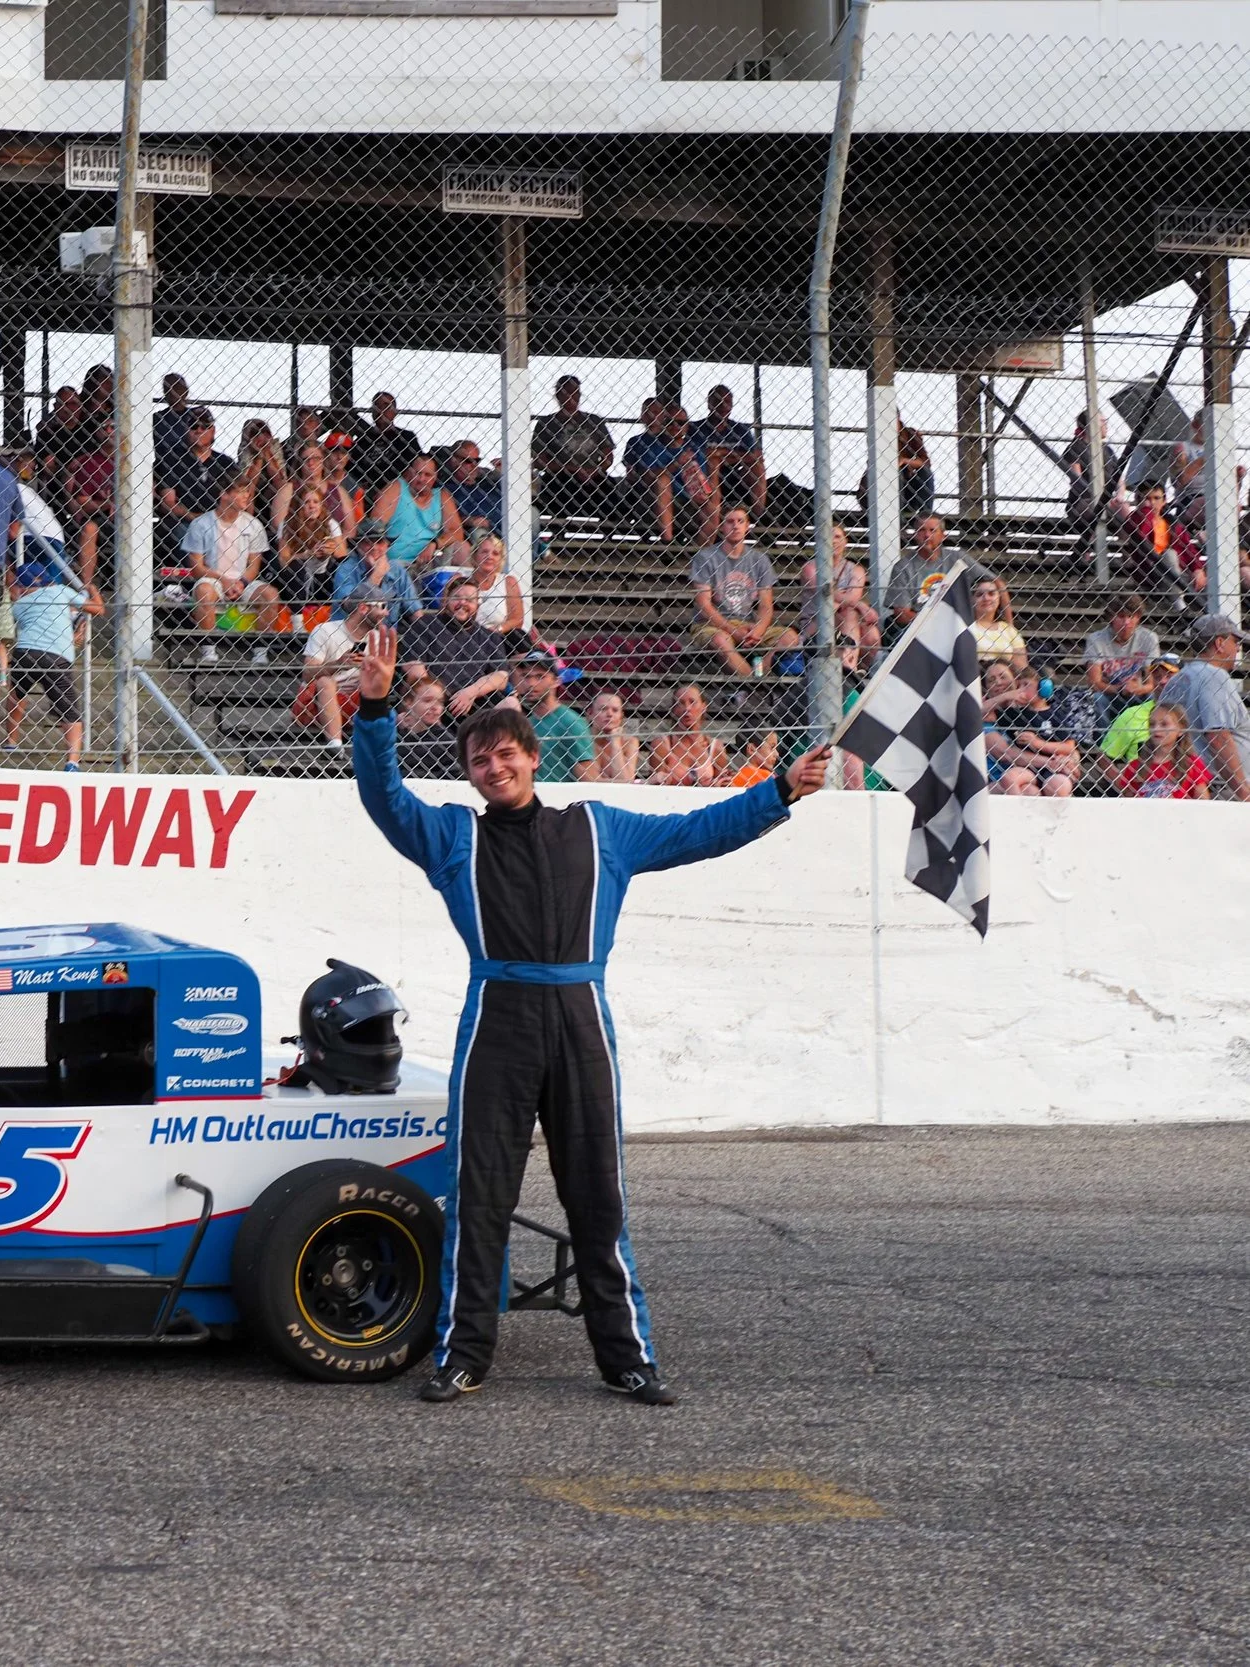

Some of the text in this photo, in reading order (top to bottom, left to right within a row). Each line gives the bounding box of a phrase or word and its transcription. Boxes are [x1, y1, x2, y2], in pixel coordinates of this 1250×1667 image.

[72, 149, 207, 173] FAMIL SECTION
[72, 170, 87, 181] NO
[89, 170, 122, 182] SMOK
[146, 173, 160, 184] NO
[162, 174, 207, 187] ALCOHOL
[449, 172, 578, 195] FAMILY SECTION
[14, 969, 54, 985] Matt
[58, 966, 100, 984] Kemp
[193, 986, 238, 999] MKR
[182, 1078, 255, 1088] CONCRETE
[150, 1110, 448, 1144] HM OutlawChassis.c
[338, 1183, 420, 1218] RACER
[286, 1322, 409, 1372] AMERICAN
